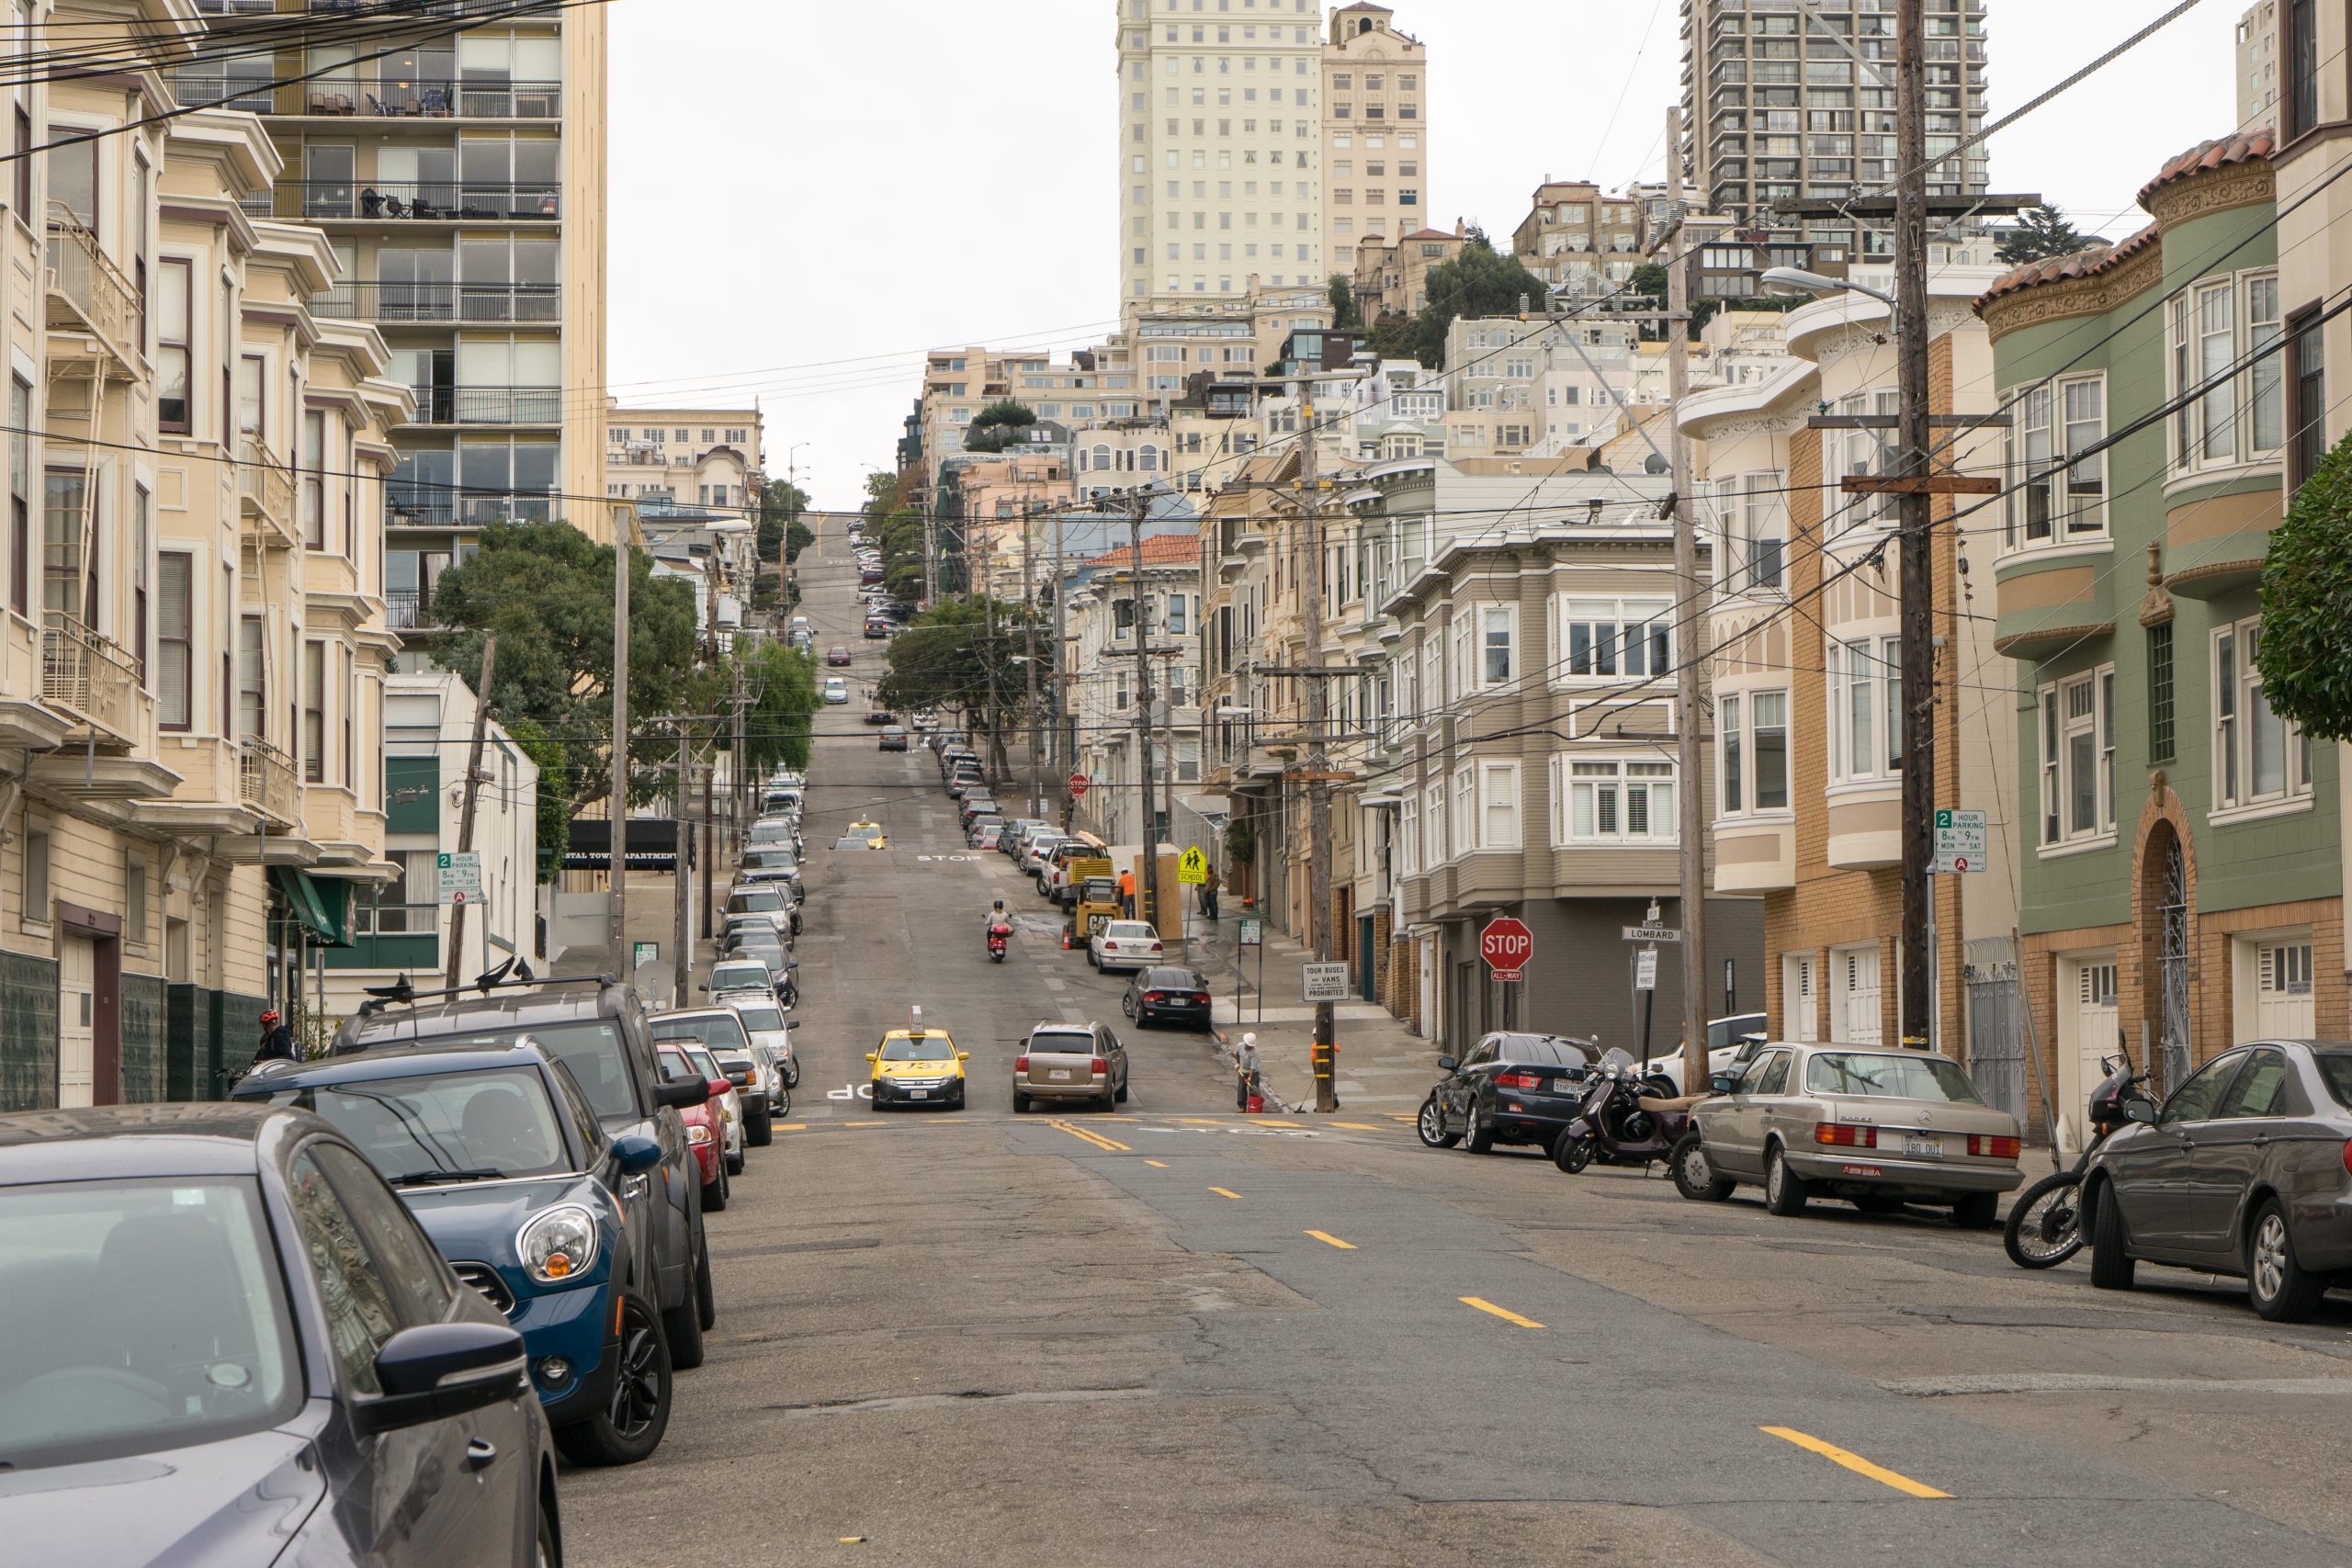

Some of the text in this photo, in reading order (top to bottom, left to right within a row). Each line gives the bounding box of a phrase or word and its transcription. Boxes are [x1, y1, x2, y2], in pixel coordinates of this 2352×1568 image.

[1069, 780, 1088, 789] STOP
[1939, 812, 1949, 826] 2
[440, 855, 448, 867] 2
[1957, 858, 1966, 869] A
[1180, 873, 1203, 882] SCHOOL
[455, 892, 464, 901] A
[1631, 929, 1674, 940] LOMBARD
[1485, 934, 1529, 954] STOP
[1492, 972, 1521, 980] ALL-WAY
